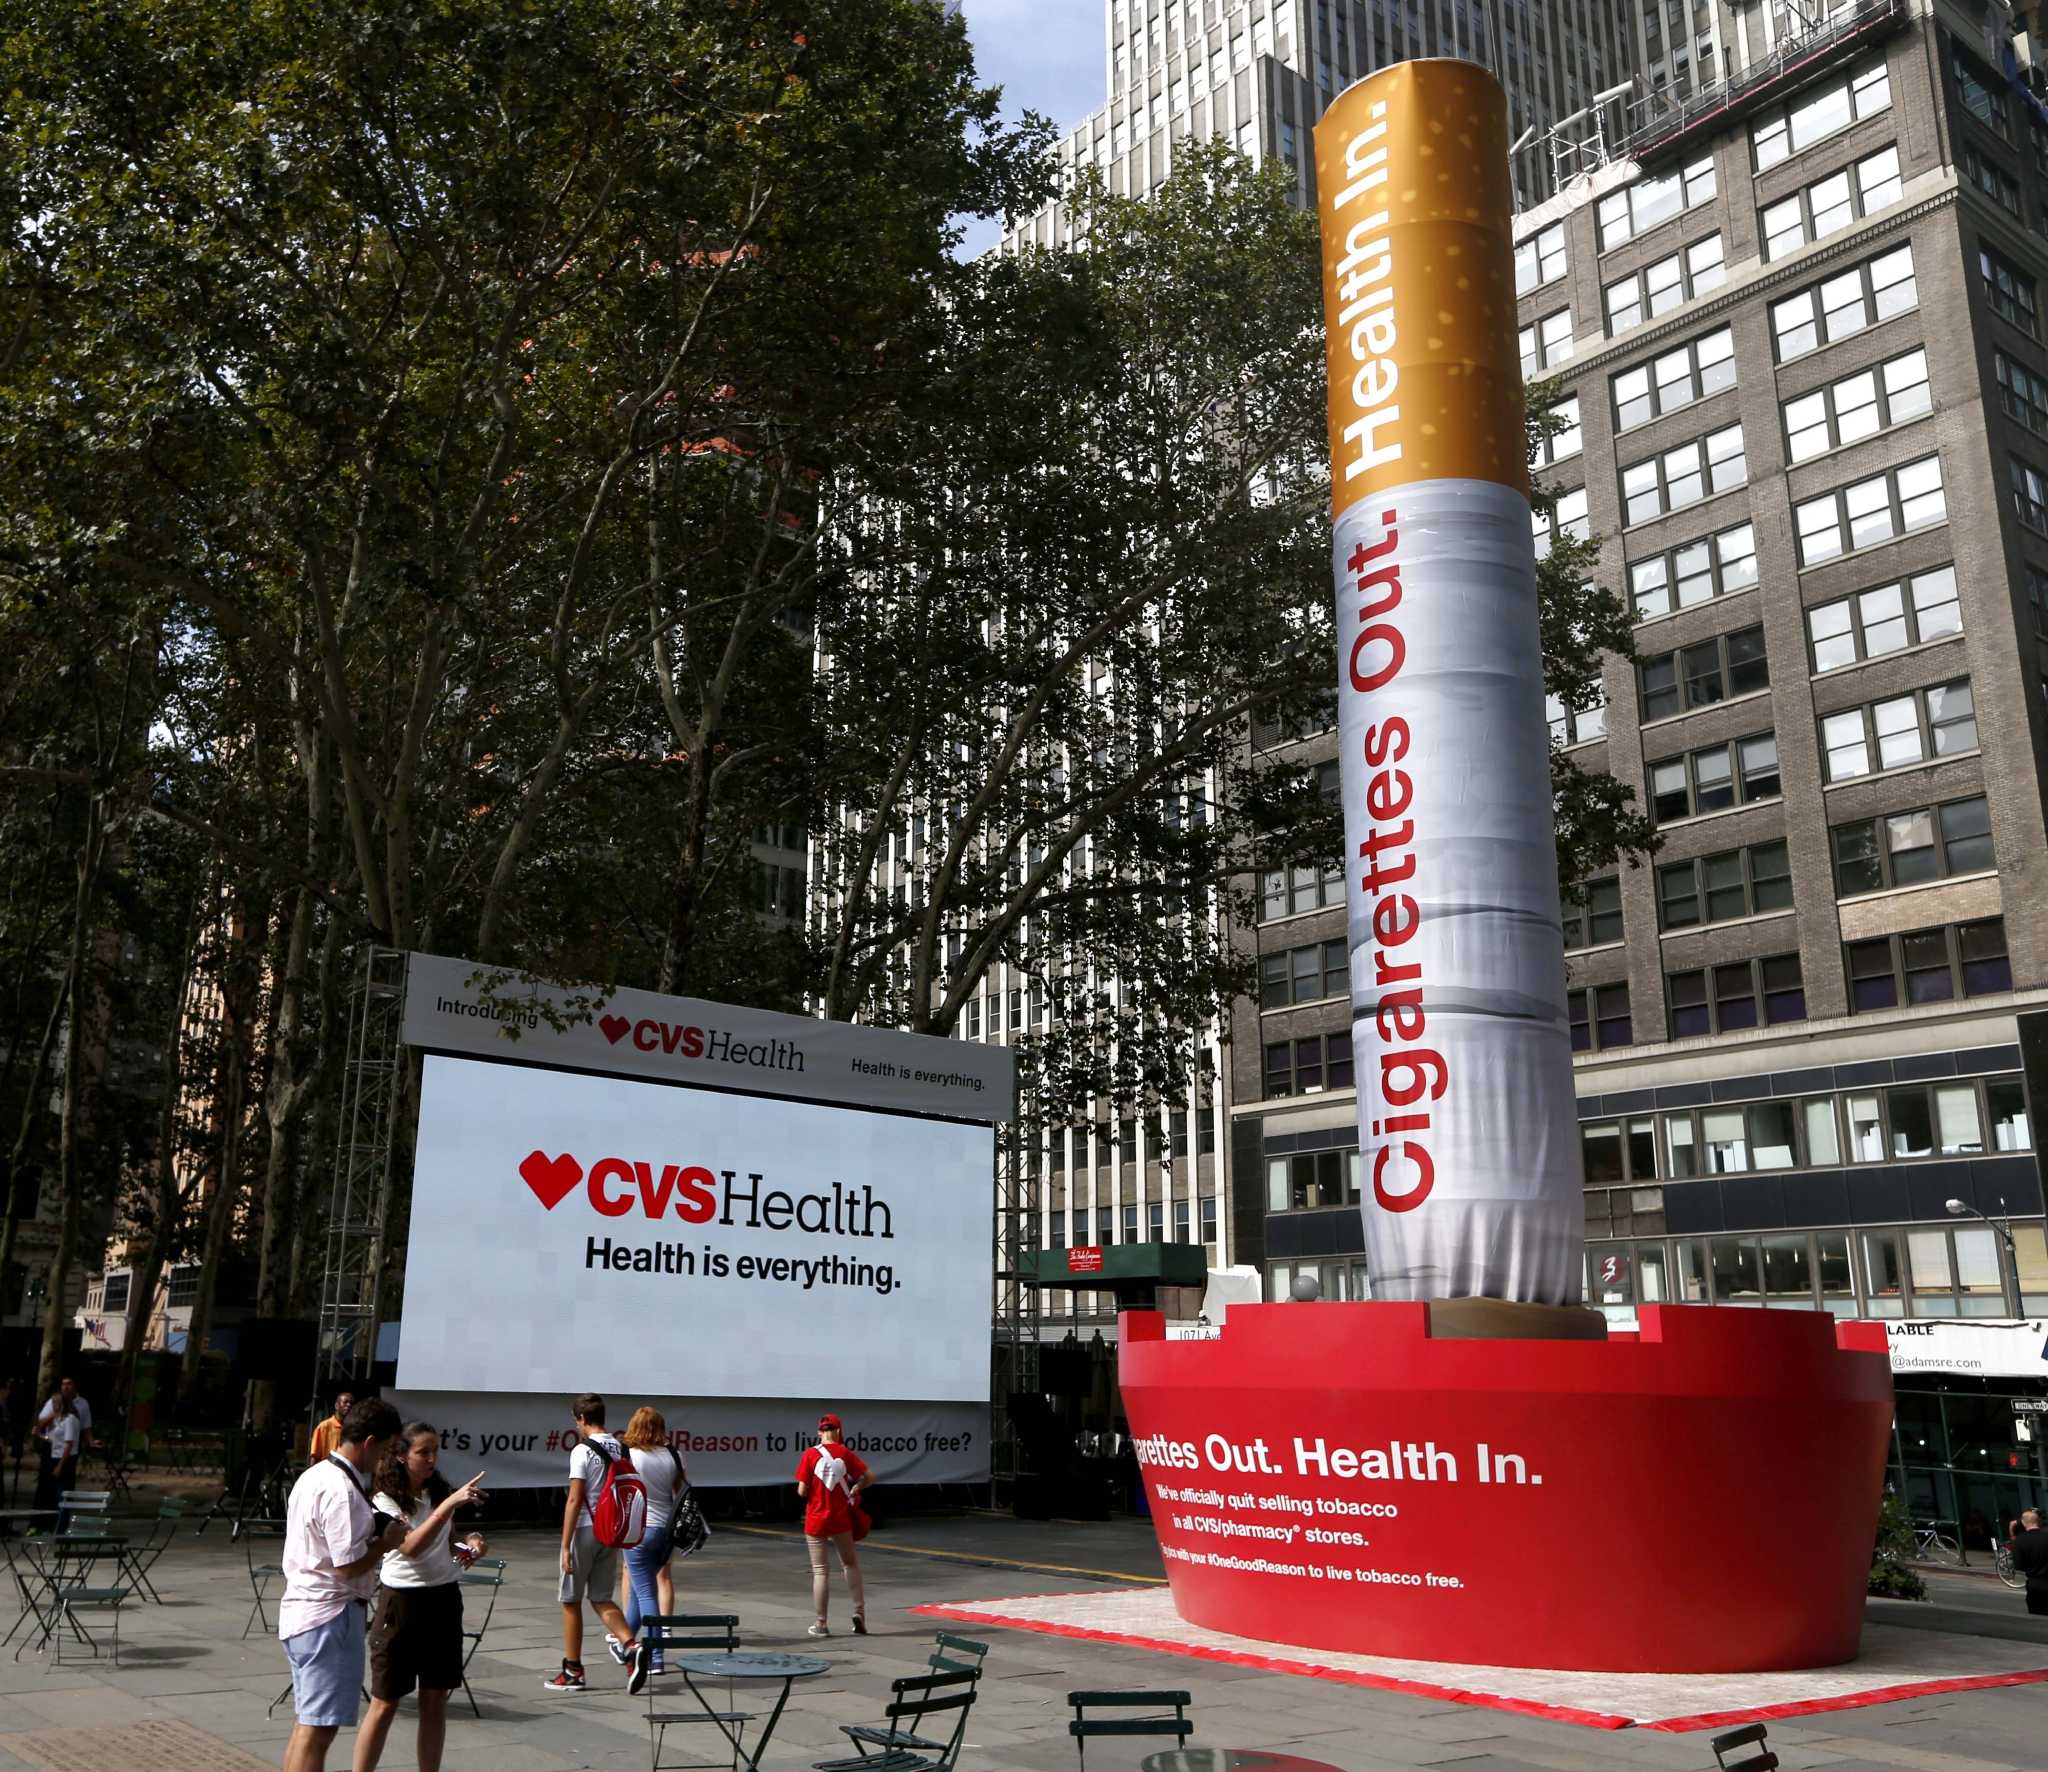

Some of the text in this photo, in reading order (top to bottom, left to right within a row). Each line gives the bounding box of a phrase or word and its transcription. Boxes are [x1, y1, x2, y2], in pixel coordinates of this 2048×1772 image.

[1334, 99, 1403, 481] Health In.
[1349, 509, 1449, 1214] Cigarettes Out.
[851, 1058, 986, 1092] Health is everything.
[585, 1236, 902, 1295] Health is everything.
[1887, 1325, 1935, 1336] LABLE
[1892, 1354, 1982, 1369] @adamsre.com
[440, 1428, 471, 1451] t's
[479, 1433, 538, 1456] your
[766, 1431, 786, 1451] to
[795, 1430, 822, 1451] liv
[844, 1432, 918, 1451] obacco
[924, 1431, 972, 1452] free?
[1204, 1433, 1283, 1474] Out.
[1293, 1437, 1458, 1482] Health
[1477, 1443, 1543, 1485] In.
[1155, 1483, 1399, 1518] We've officially quit selling tobacco
[1172, 1512, 1182, 1528] in
[1182, 1514, 1194, 1531] all
[1304, 1527, 1370, 1546] stores.
[1190, 1552, 1206, 1565] your
[1207, 1553, 1306, 1577] #OneGoodReason
[1308, 1564, 1323, 1579] to
[1326, 1565, 1353, 1580] live
[1355, 1567, 1422, 1586] tobacco
[1424, 1572, 1465, 1589] free.
